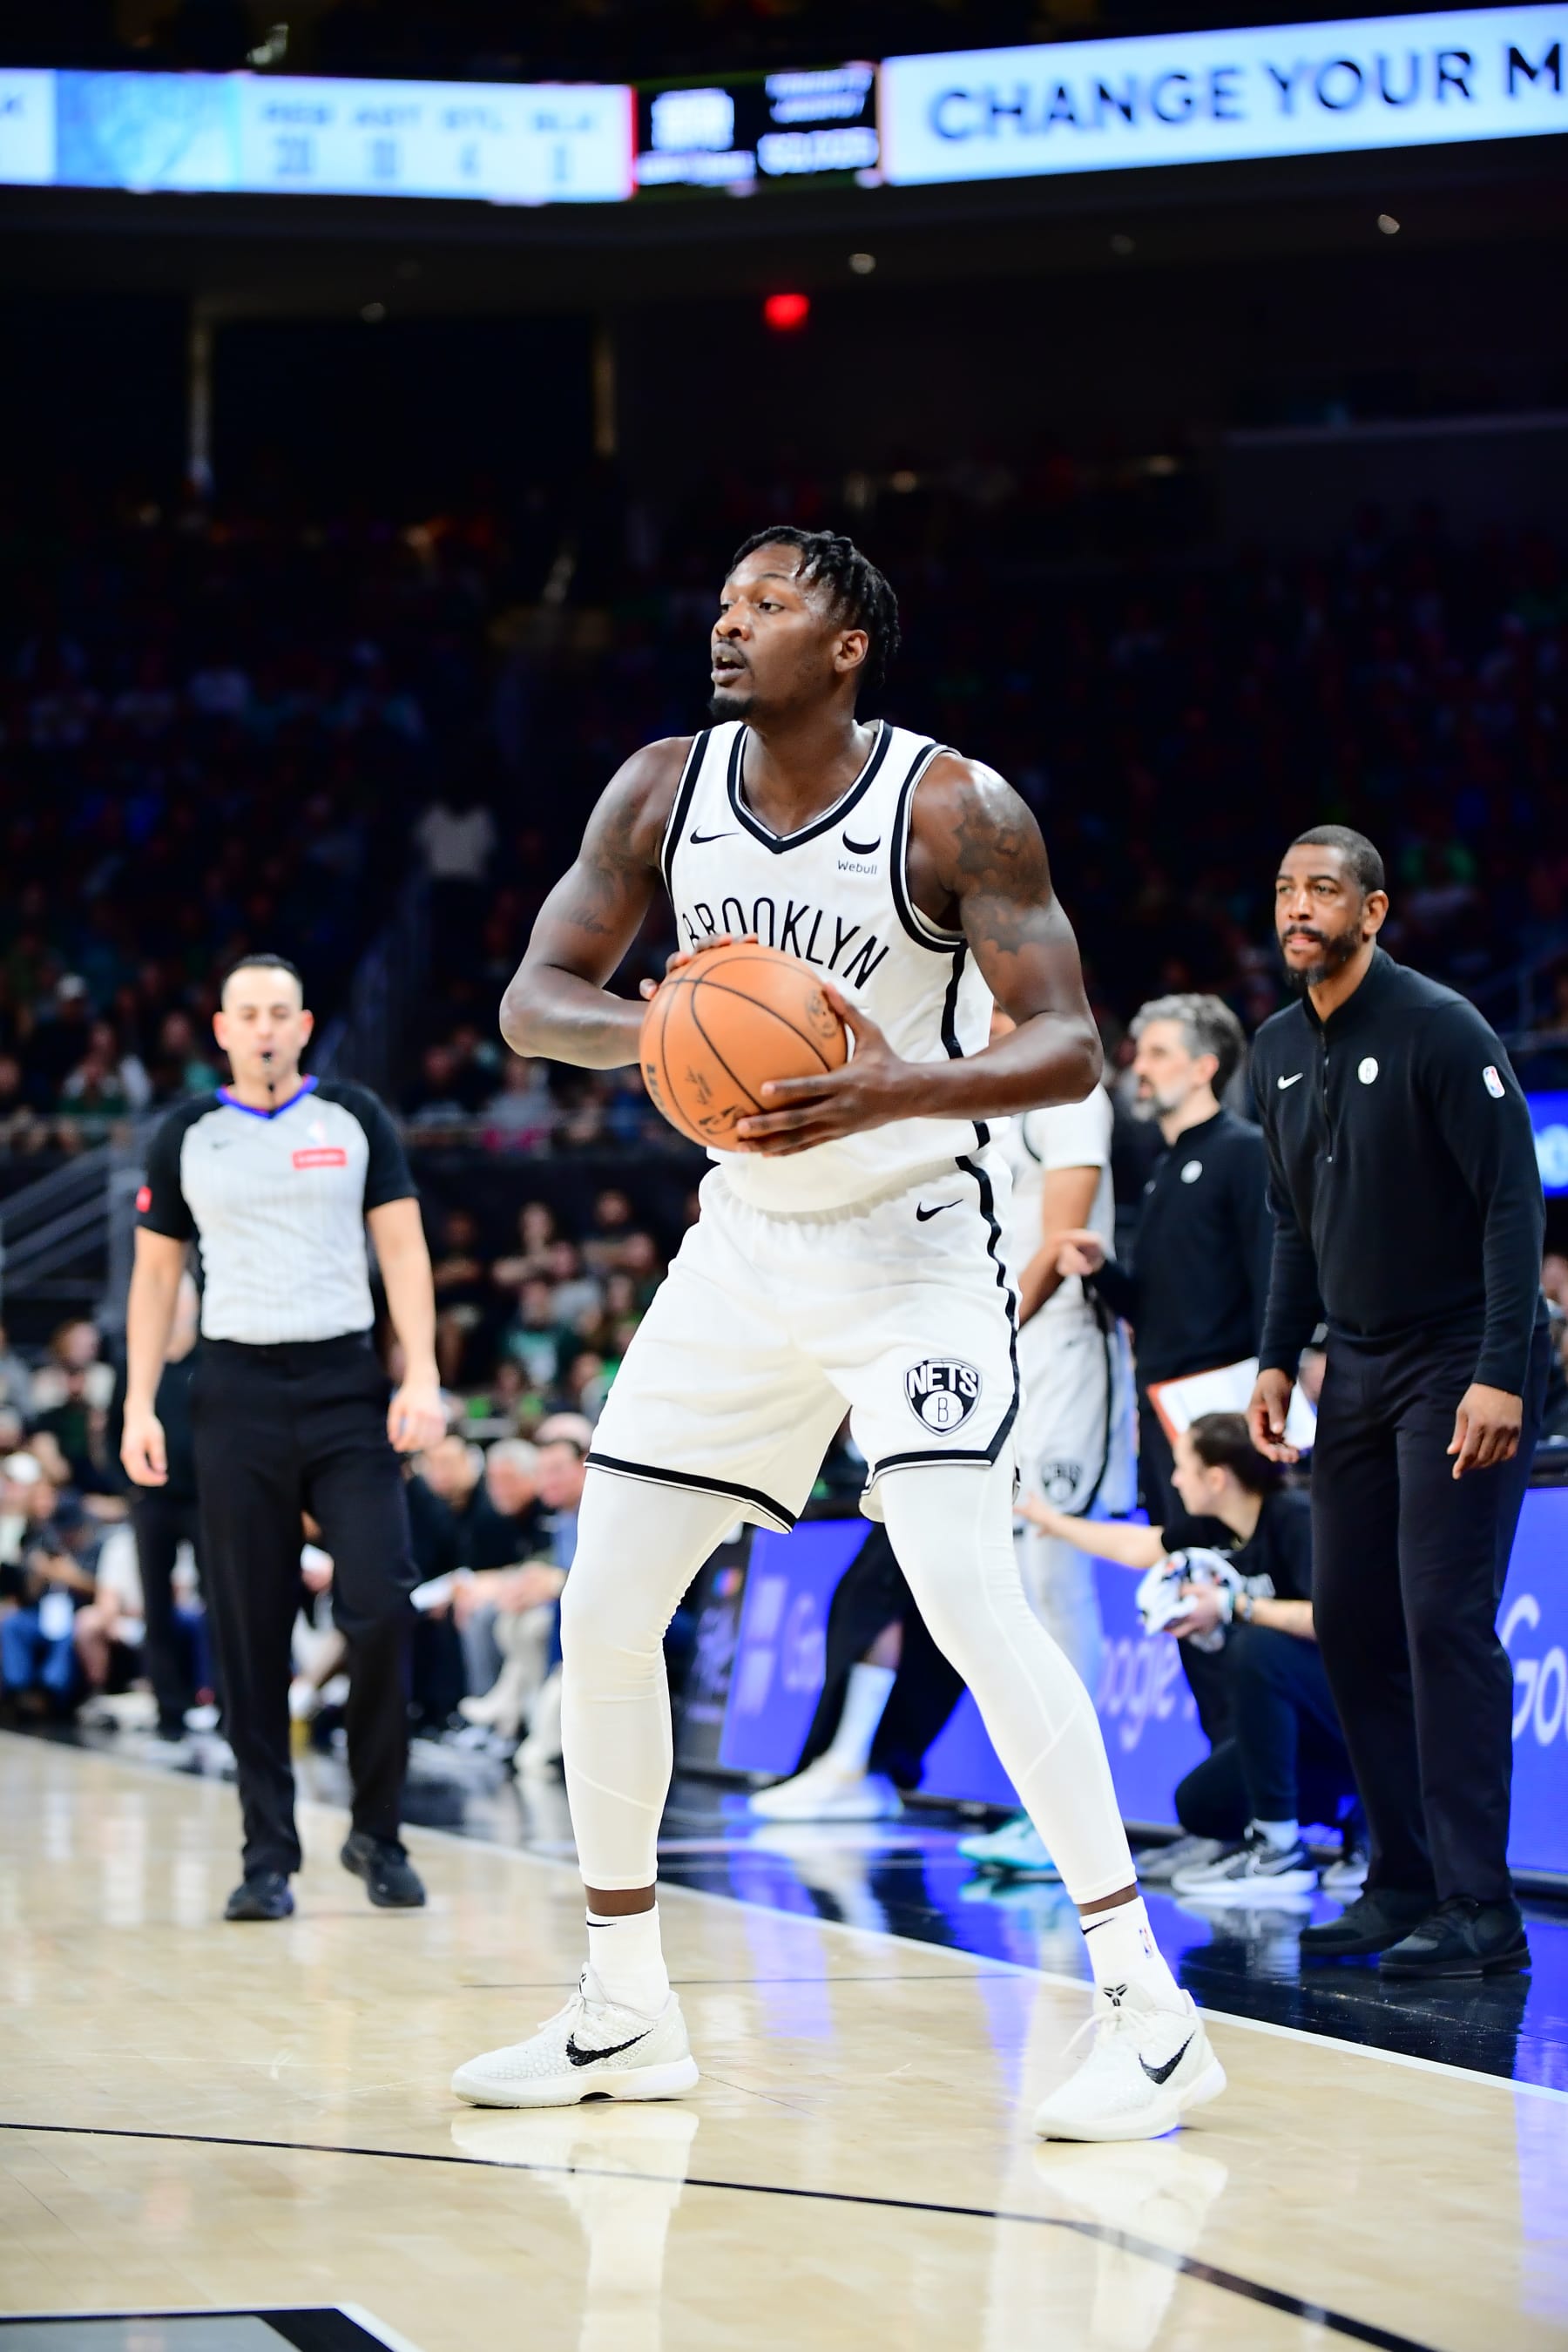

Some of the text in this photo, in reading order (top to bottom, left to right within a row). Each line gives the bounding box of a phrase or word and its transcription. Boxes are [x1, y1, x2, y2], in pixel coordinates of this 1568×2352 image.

[931, 67, 1242, 139] CHANGE
[1261, 51, 1473, 117] YOUR
[1506, 42, 1563, 95] M
[837, 859, 878, 875] Webull
[682, 897, 889, 990] BROOKLYN
[908, 1362, 978, 1399] NETS
[937, 1396, 949, 1423] B
[1500, 1593, 1568, 1747] Go
